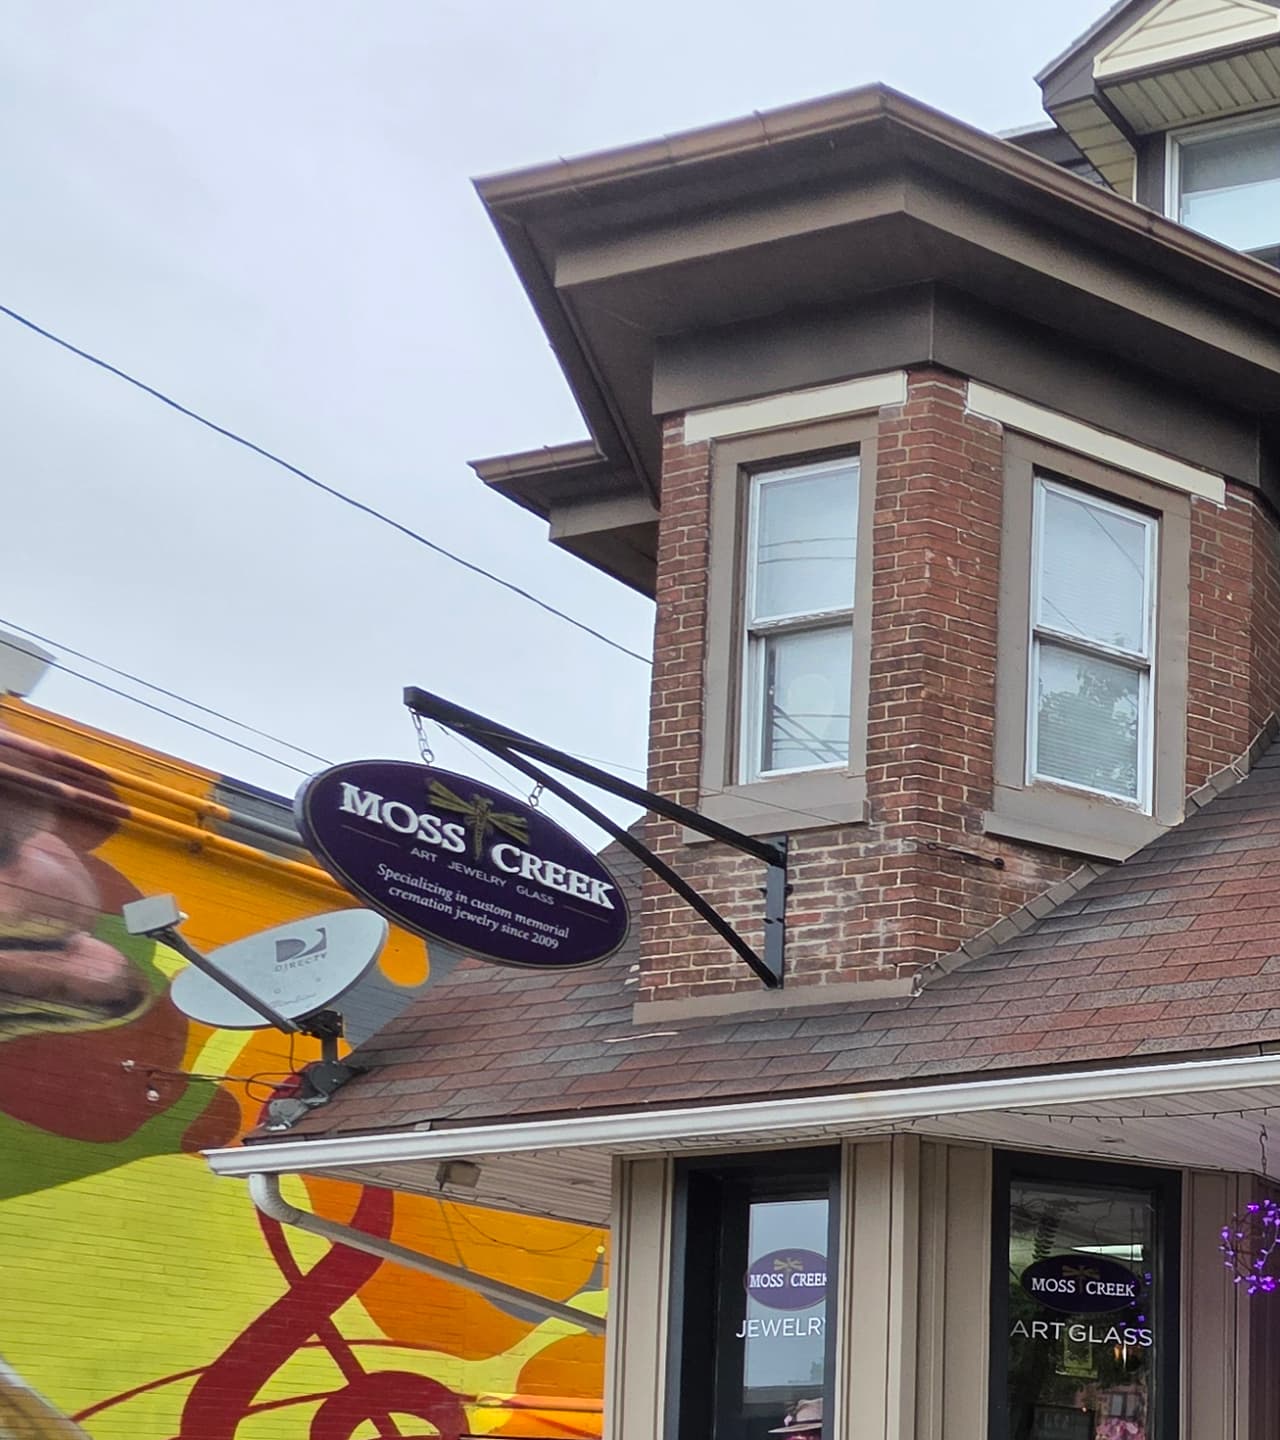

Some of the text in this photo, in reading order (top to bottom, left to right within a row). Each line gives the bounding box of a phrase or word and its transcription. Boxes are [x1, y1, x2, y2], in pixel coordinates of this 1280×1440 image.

[339, 782, 616, 910] MOSS CREEK
[410, 847, 555, 905] ART JEWELRY GLASS
[377, 863, 570, 938] Specializing in custom memorial
[388, 886, 559, 949] cremation jewelry since 2009
[749, 1273, 784, 1288] MOSS
[1032, 1277, 1136, 1297] MOSS CREEK
[736, 1316, 825, 1338] JEWELR
[1010, 1320, 1153, 1346] ART GLASS
